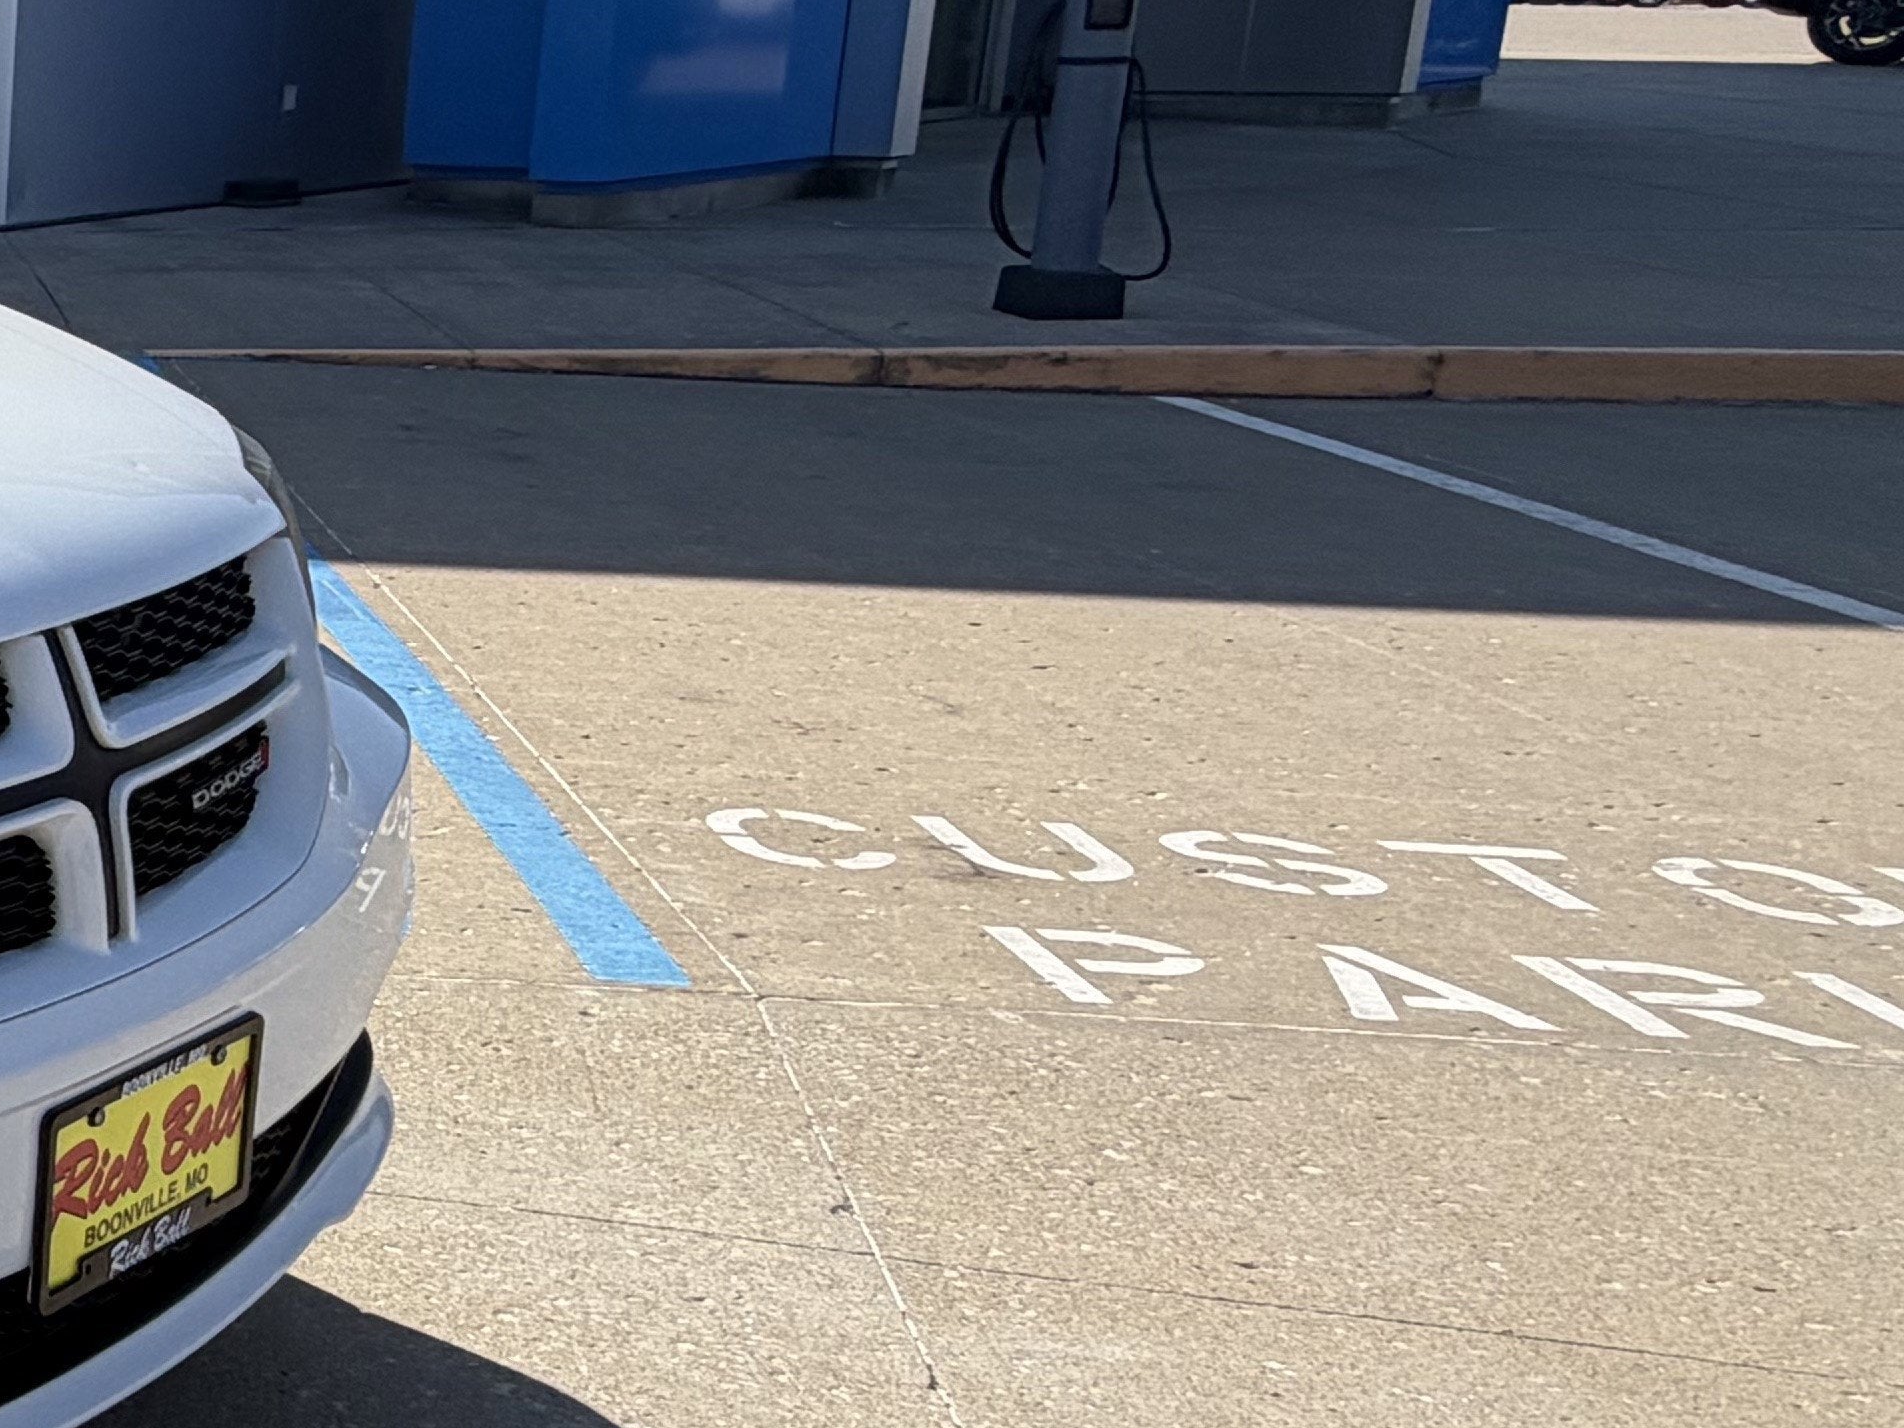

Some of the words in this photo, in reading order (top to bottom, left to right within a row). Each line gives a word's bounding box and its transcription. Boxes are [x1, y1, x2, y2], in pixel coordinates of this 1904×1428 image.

[192, 754, 262, 809] DODGE
[705, 809, 1904, 927] CUSTO
[52, 1112, 150, 1225] Rick
[161, 1062, 249, 1175] Ball
[84, 1180, 181, 1248] BOONVILLE,
[185, 1163, 209, 1194] MO
